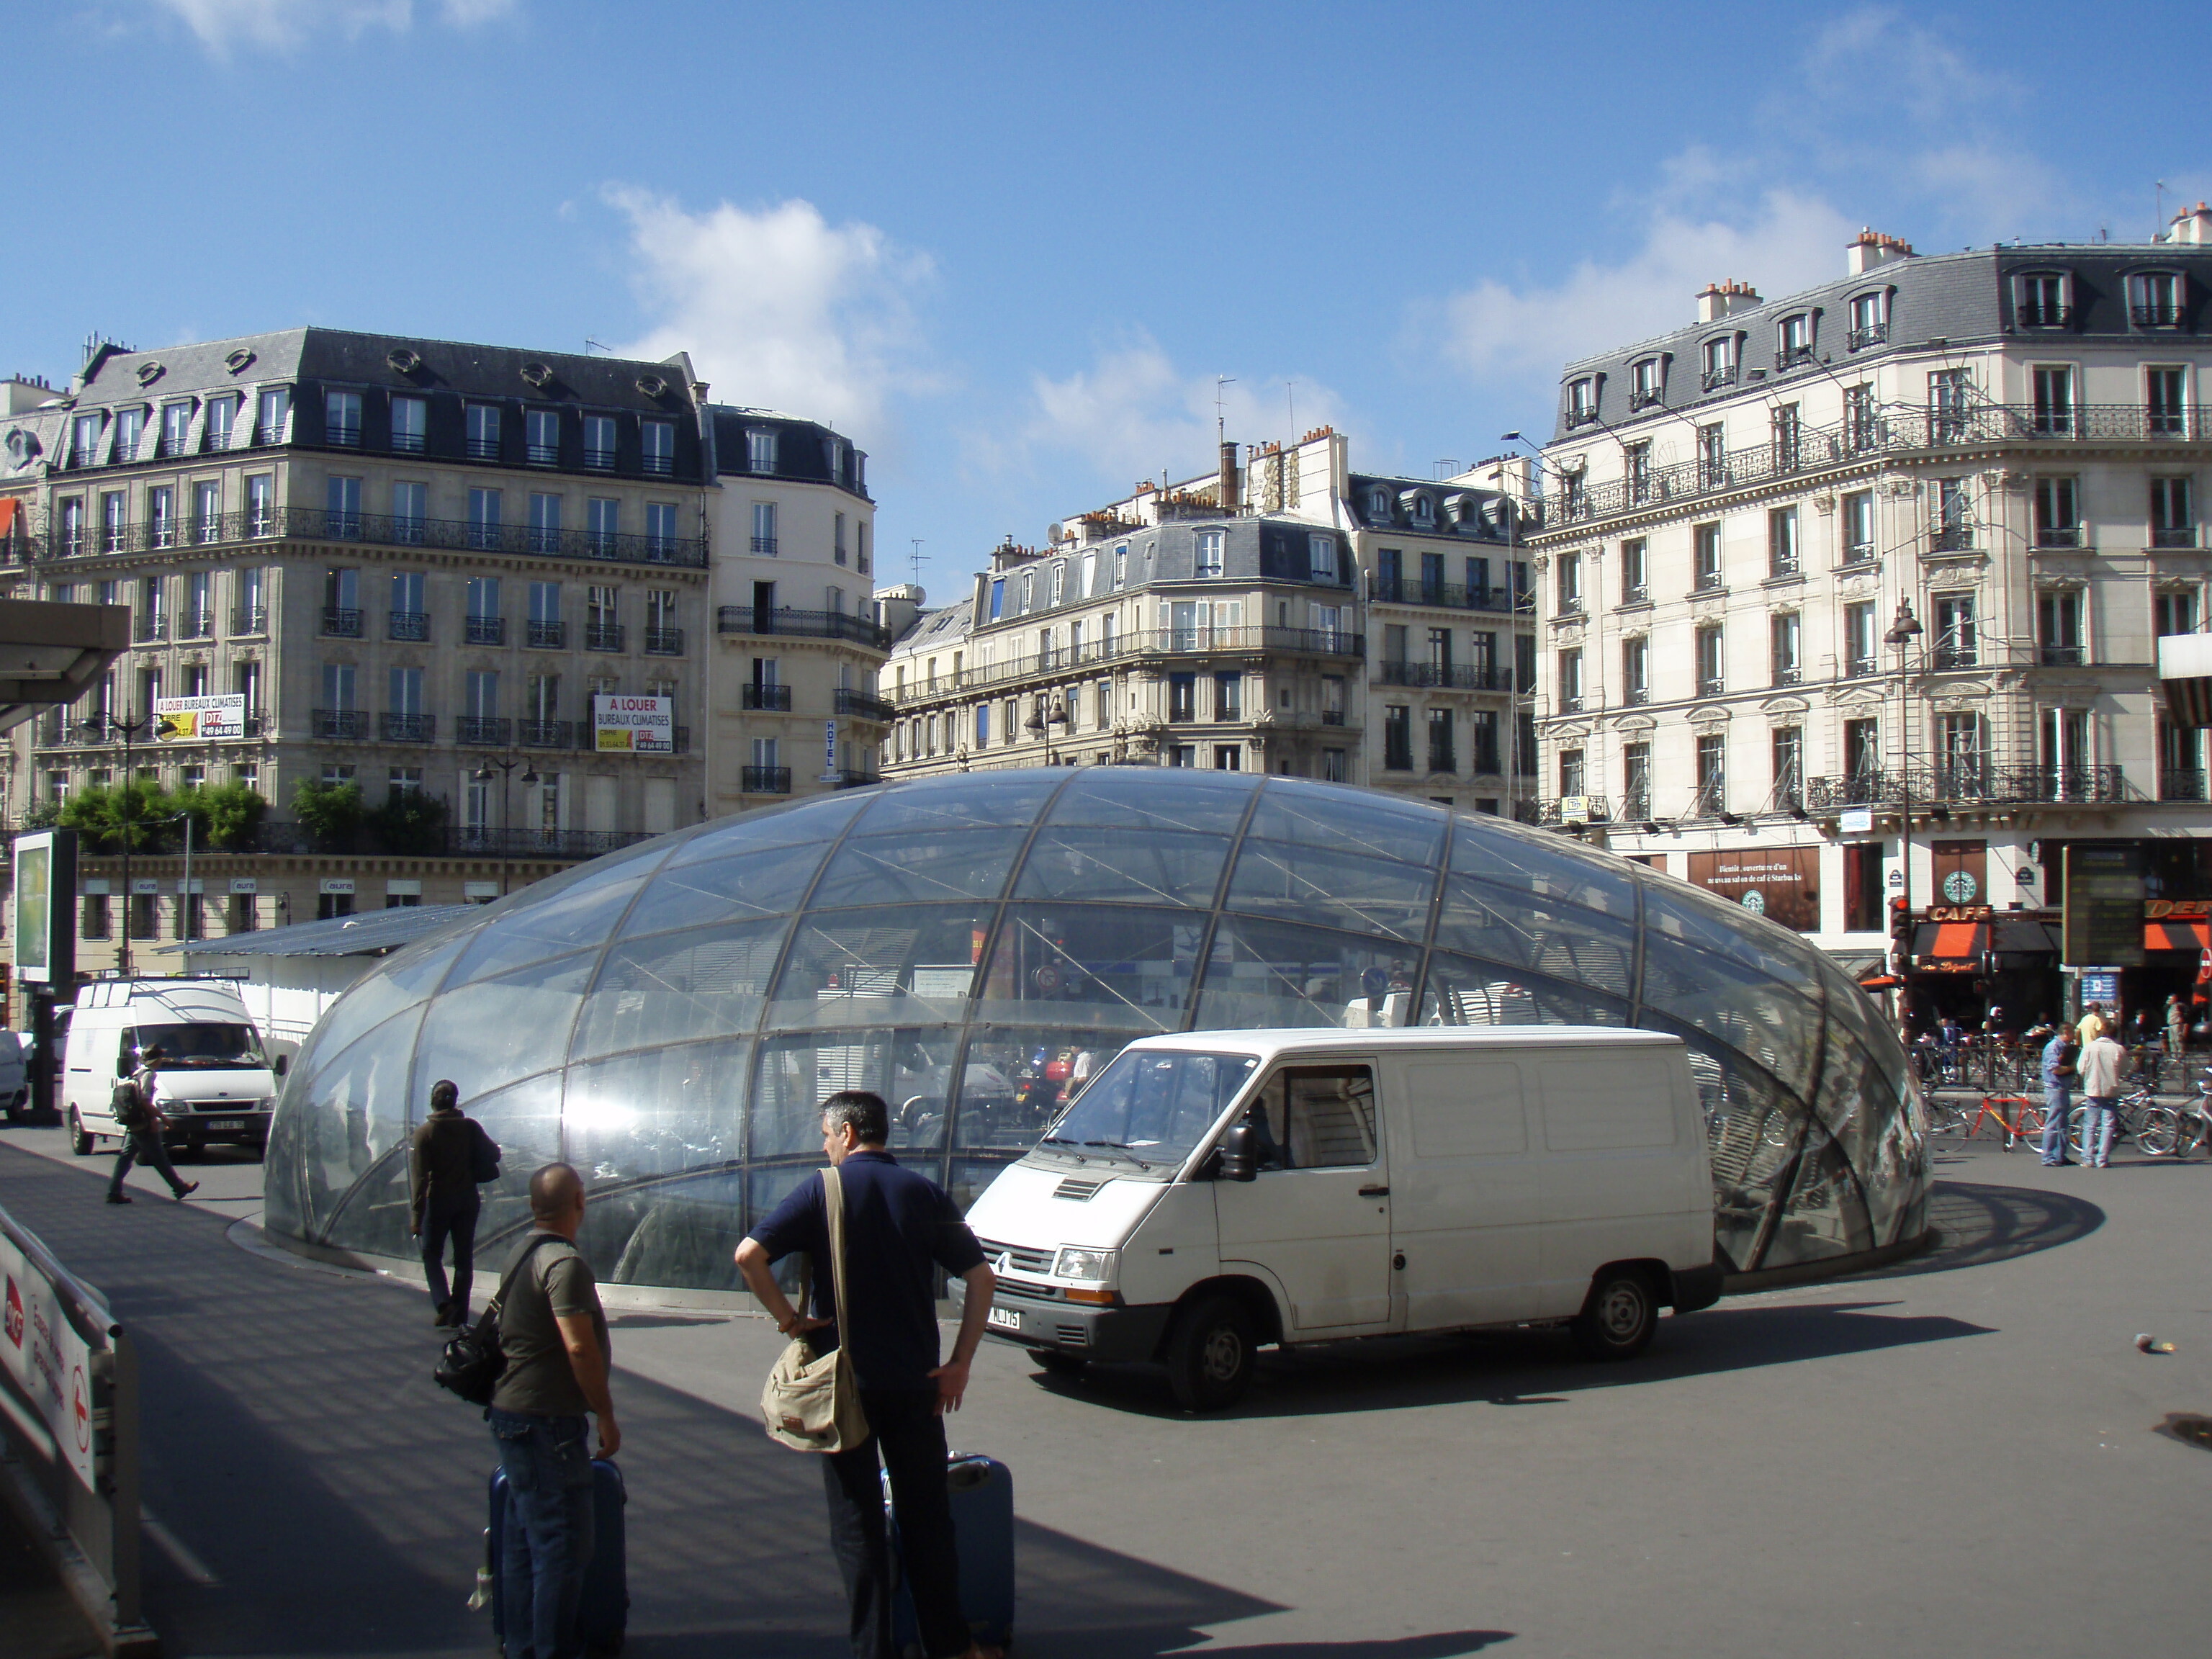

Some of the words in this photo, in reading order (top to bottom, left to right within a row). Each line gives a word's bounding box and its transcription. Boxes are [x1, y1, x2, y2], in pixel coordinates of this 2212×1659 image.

[160, 701, 164, 711] A
[166, 700, 183, 711] LOUER
[184, 698, 210, 710] BUREAUX
[212, 696, 242, 709] CLIMATISES
[610, 698, 618, 710] A
[622, 698, 657, 711] LOUER
[205, 711, 222, 724] DTZ
[598, 714, 630, 725] BUREAUX
[632, 714, 669, 726] CLIMATISES
[206, 727, 214, 735] 49
[215, 726, 222, 735] 64
[223, 726, 232, 734] 49
[1930, 907, 1990, 921] CAFE
